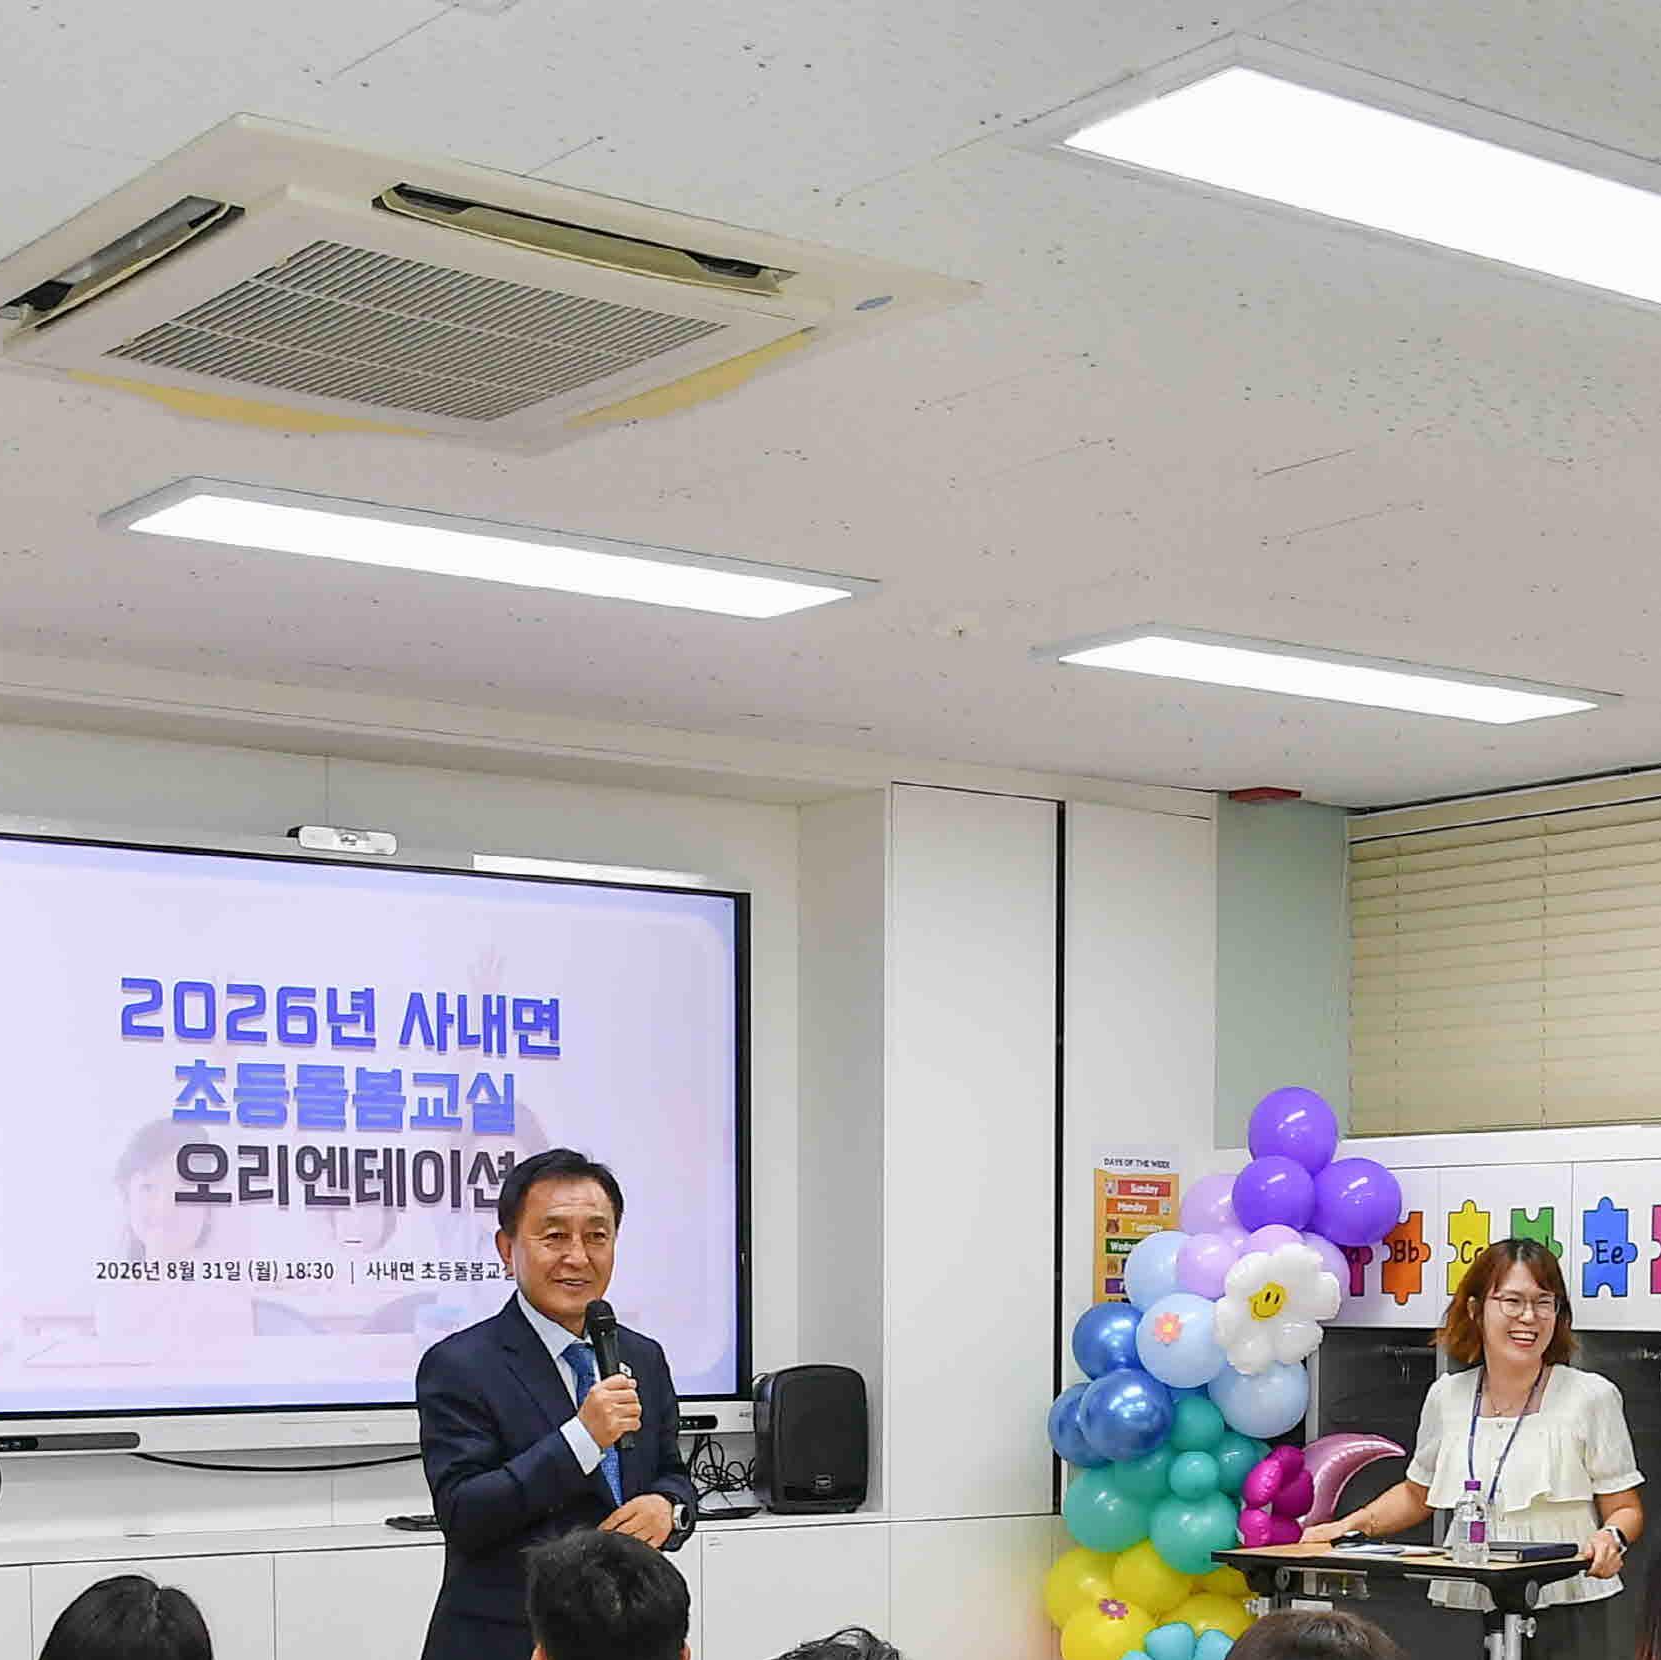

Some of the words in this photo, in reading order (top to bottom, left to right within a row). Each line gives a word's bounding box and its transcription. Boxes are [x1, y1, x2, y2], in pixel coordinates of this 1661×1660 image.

[120, 977, 377, 1049] 2026년
[398, 991, 562, 1058] 사내면
[171, 1058, 517, 1135] 초등돌봄교실
[1393, 1240, 1420, 1263] Bb
[1595, 1239, 1625, 1265] Ee
[96, 1261, 161, 1282] 2026년
[166, 1261, 196, 1282] 8월
[202, 1261, 242, 1282] 31일
[248, 1260, 279, 1283] (월)
[285, 1261, 335, 1280] 18:30
[366, 1261, 415, 1281] 사내면
